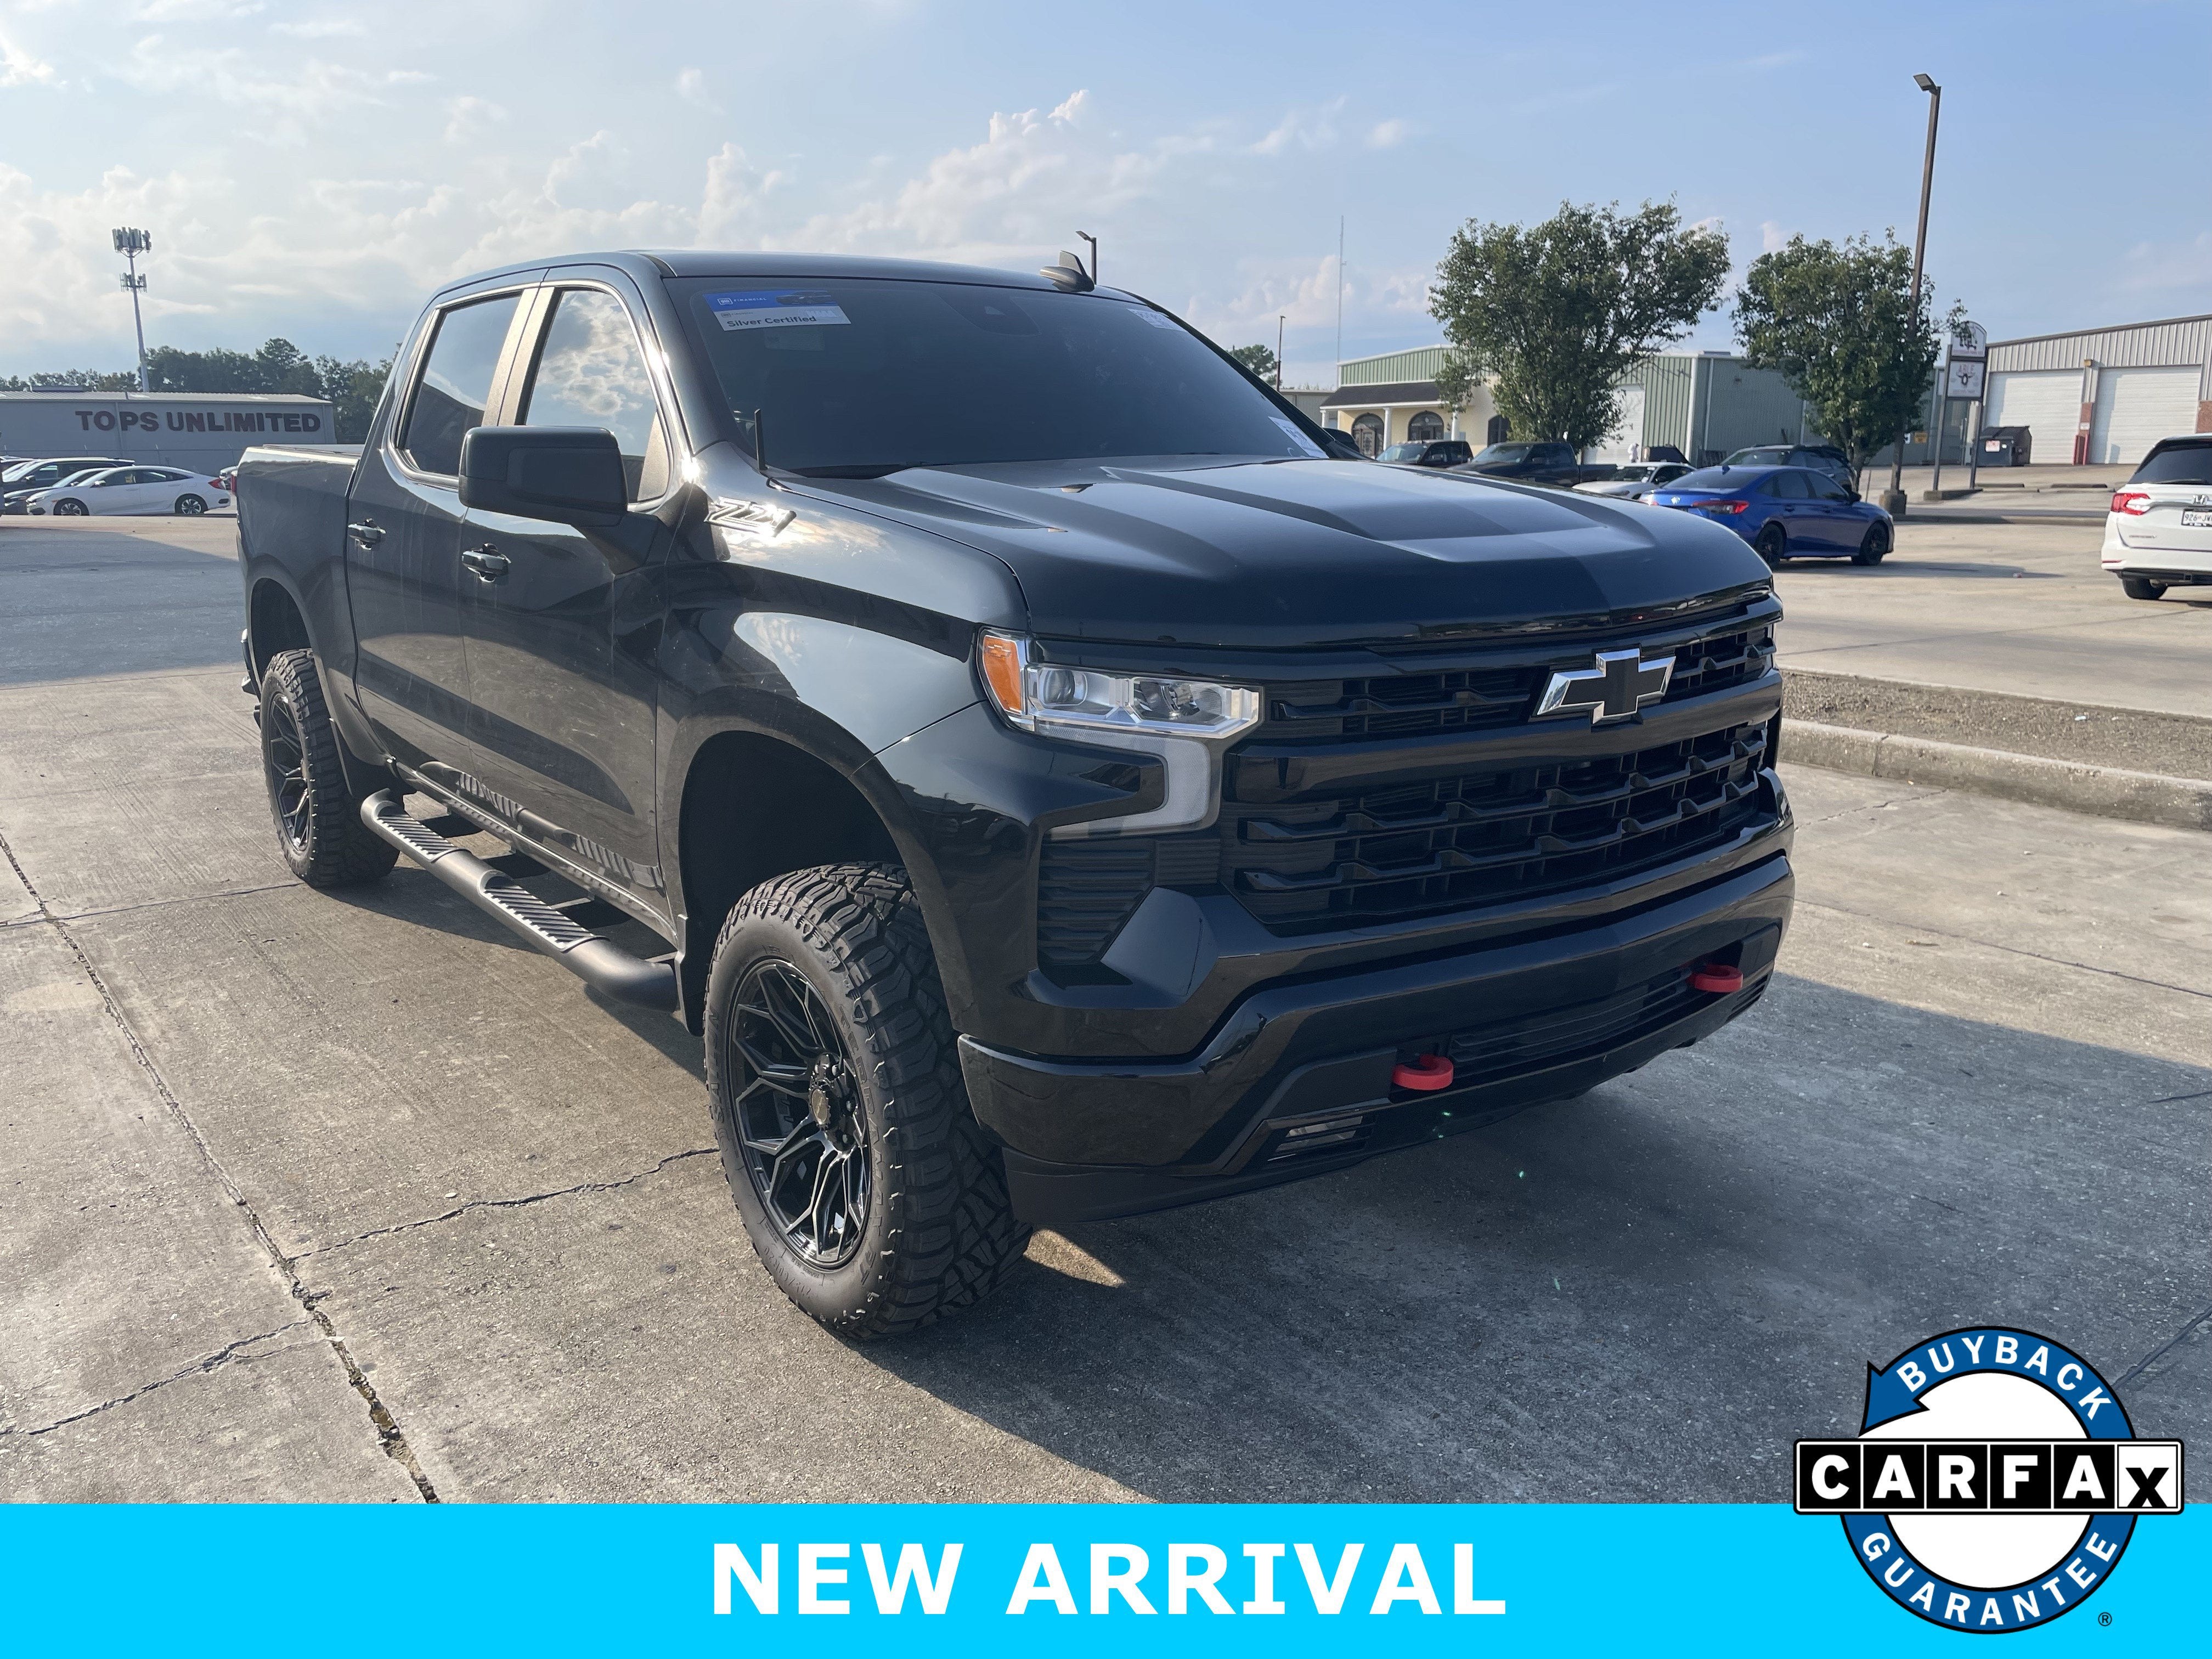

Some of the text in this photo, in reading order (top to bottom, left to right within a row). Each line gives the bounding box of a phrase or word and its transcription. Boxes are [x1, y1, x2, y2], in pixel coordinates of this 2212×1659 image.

[726, 316, 817, 328] Silver Certified
[75, 410, 320, 432] TOPS UNLIMITED
